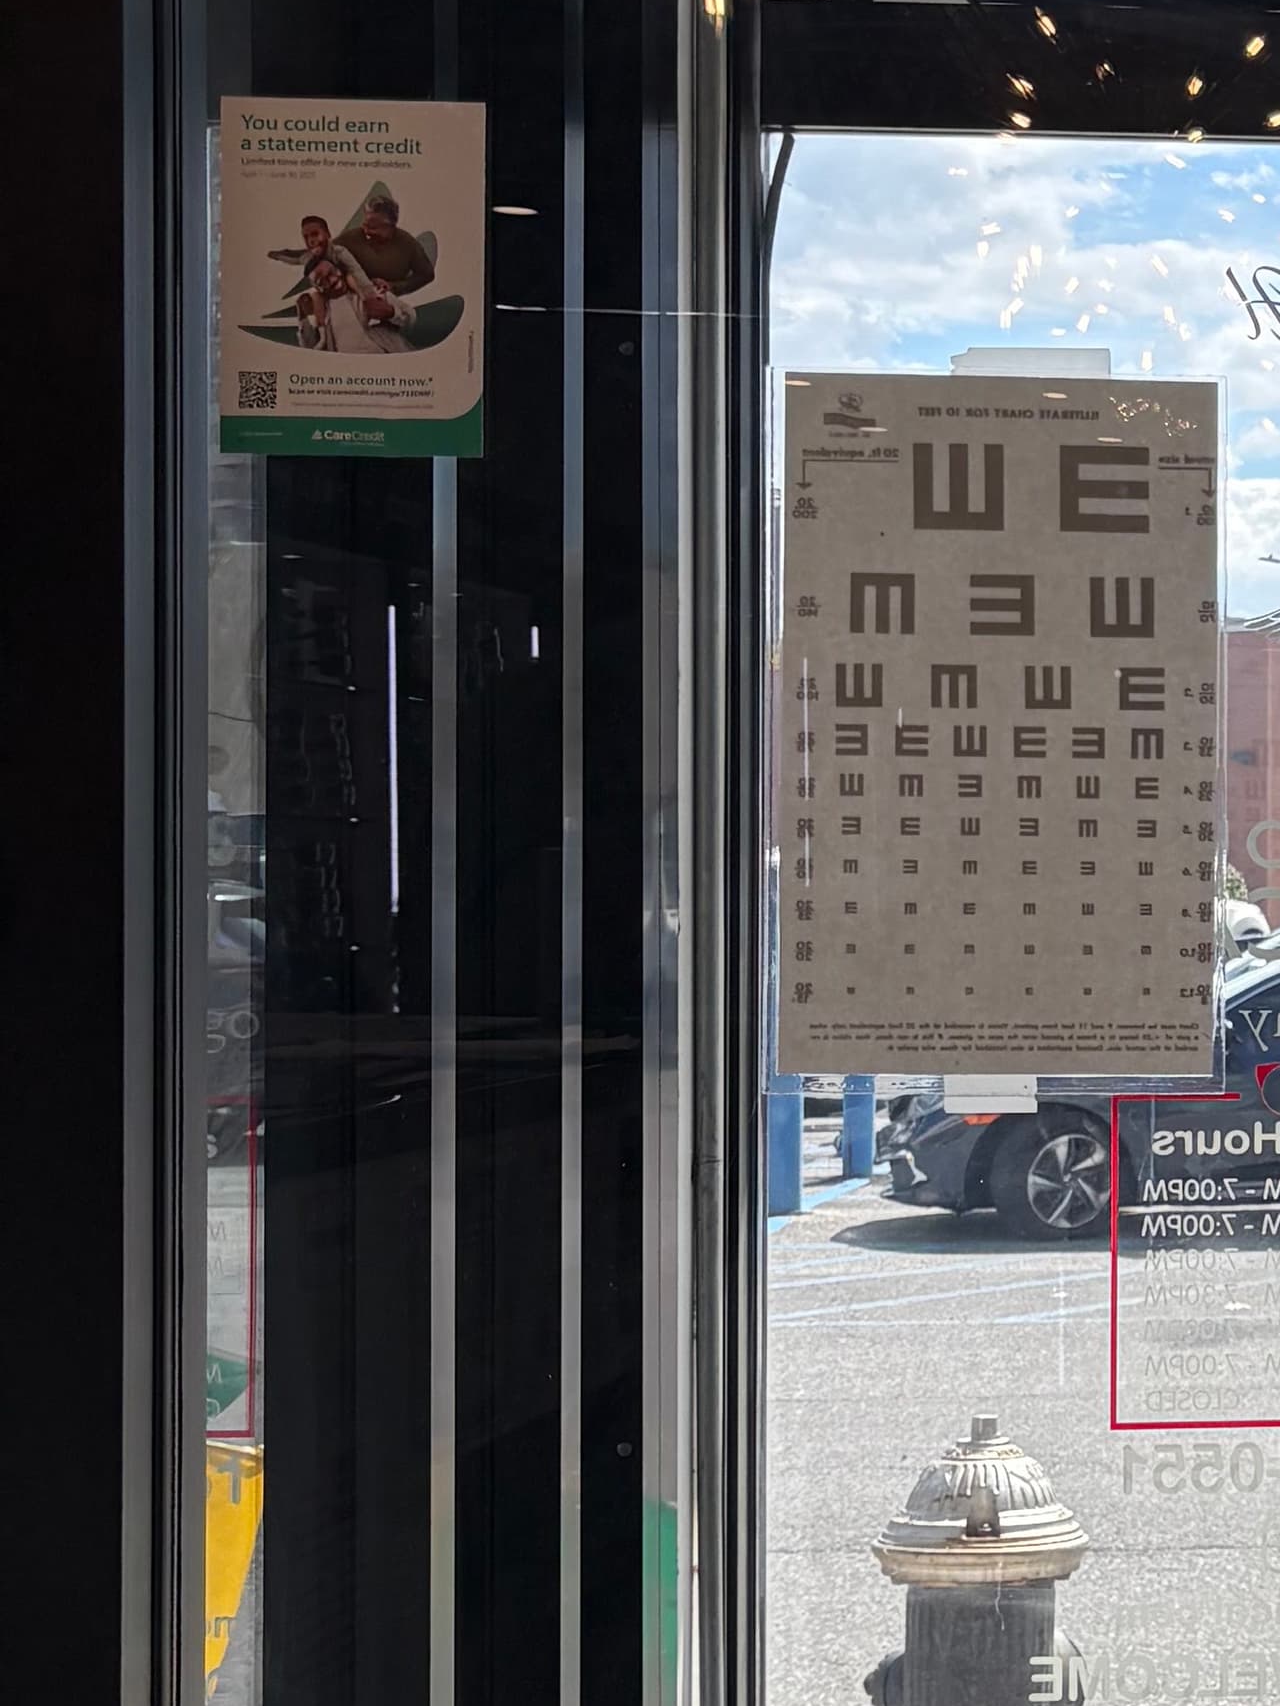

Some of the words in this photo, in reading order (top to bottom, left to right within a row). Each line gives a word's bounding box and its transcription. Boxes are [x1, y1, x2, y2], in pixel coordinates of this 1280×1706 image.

[241, 114, 277, 130] You
[284, 116, 339, 132] could
[345, 121, 389, 133] earn
[241, 138, 251, 150] a
[258, 137, 359, 153] statement
[365, 138, 422, 154] credit
[290, 374, 325, 388] Open
[328, 376, 342, 386] an
[346, 376, 396, 387] account
